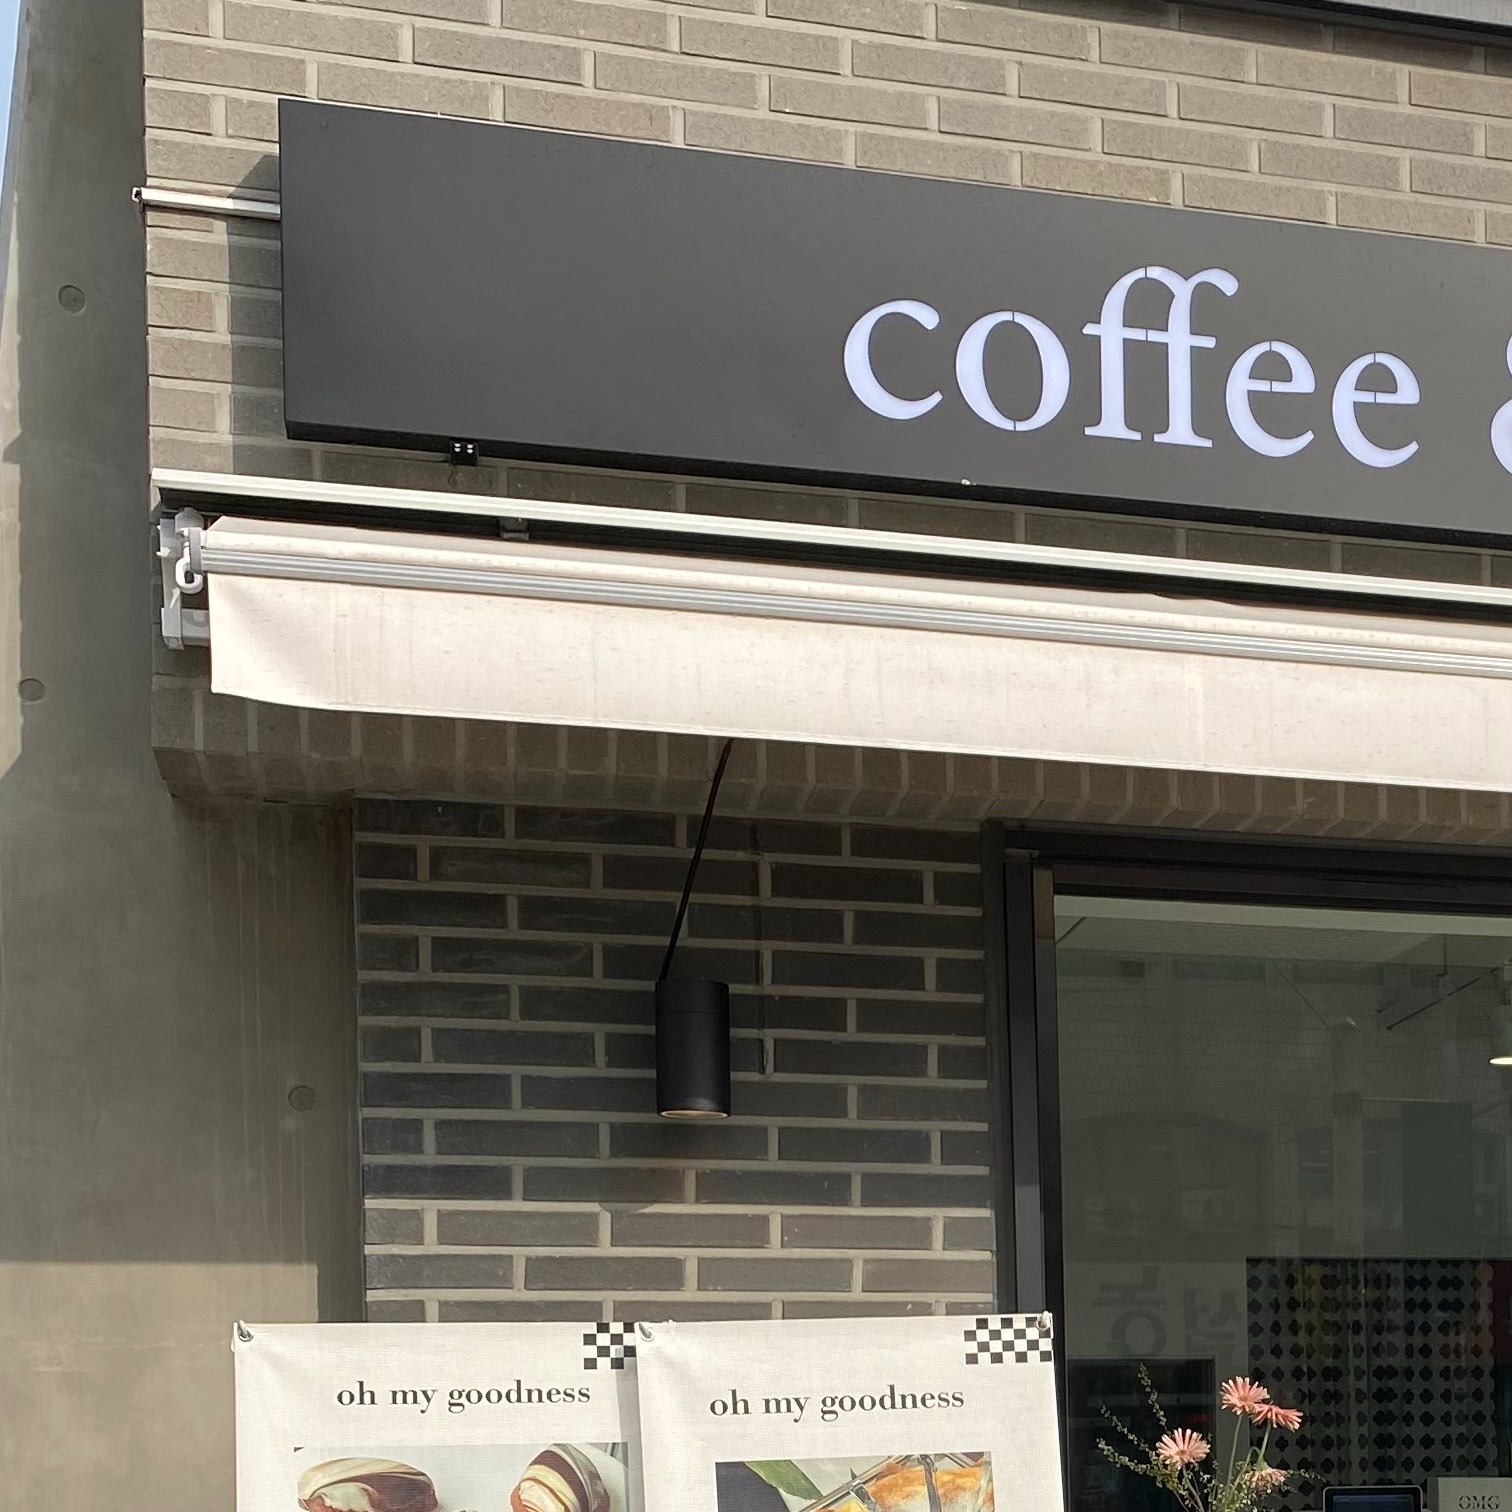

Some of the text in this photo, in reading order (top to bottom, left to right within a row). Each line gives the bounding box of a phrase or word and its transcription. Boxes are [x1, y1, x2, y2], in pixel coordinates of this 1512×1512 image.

[843, 264, 1421, 468] coffee
[336, 1379, 592, 1414] oh my goodness
[709, 1384, 965, 1423] oh my goodness
[1458, 1495, 1501, 1511] OMG
